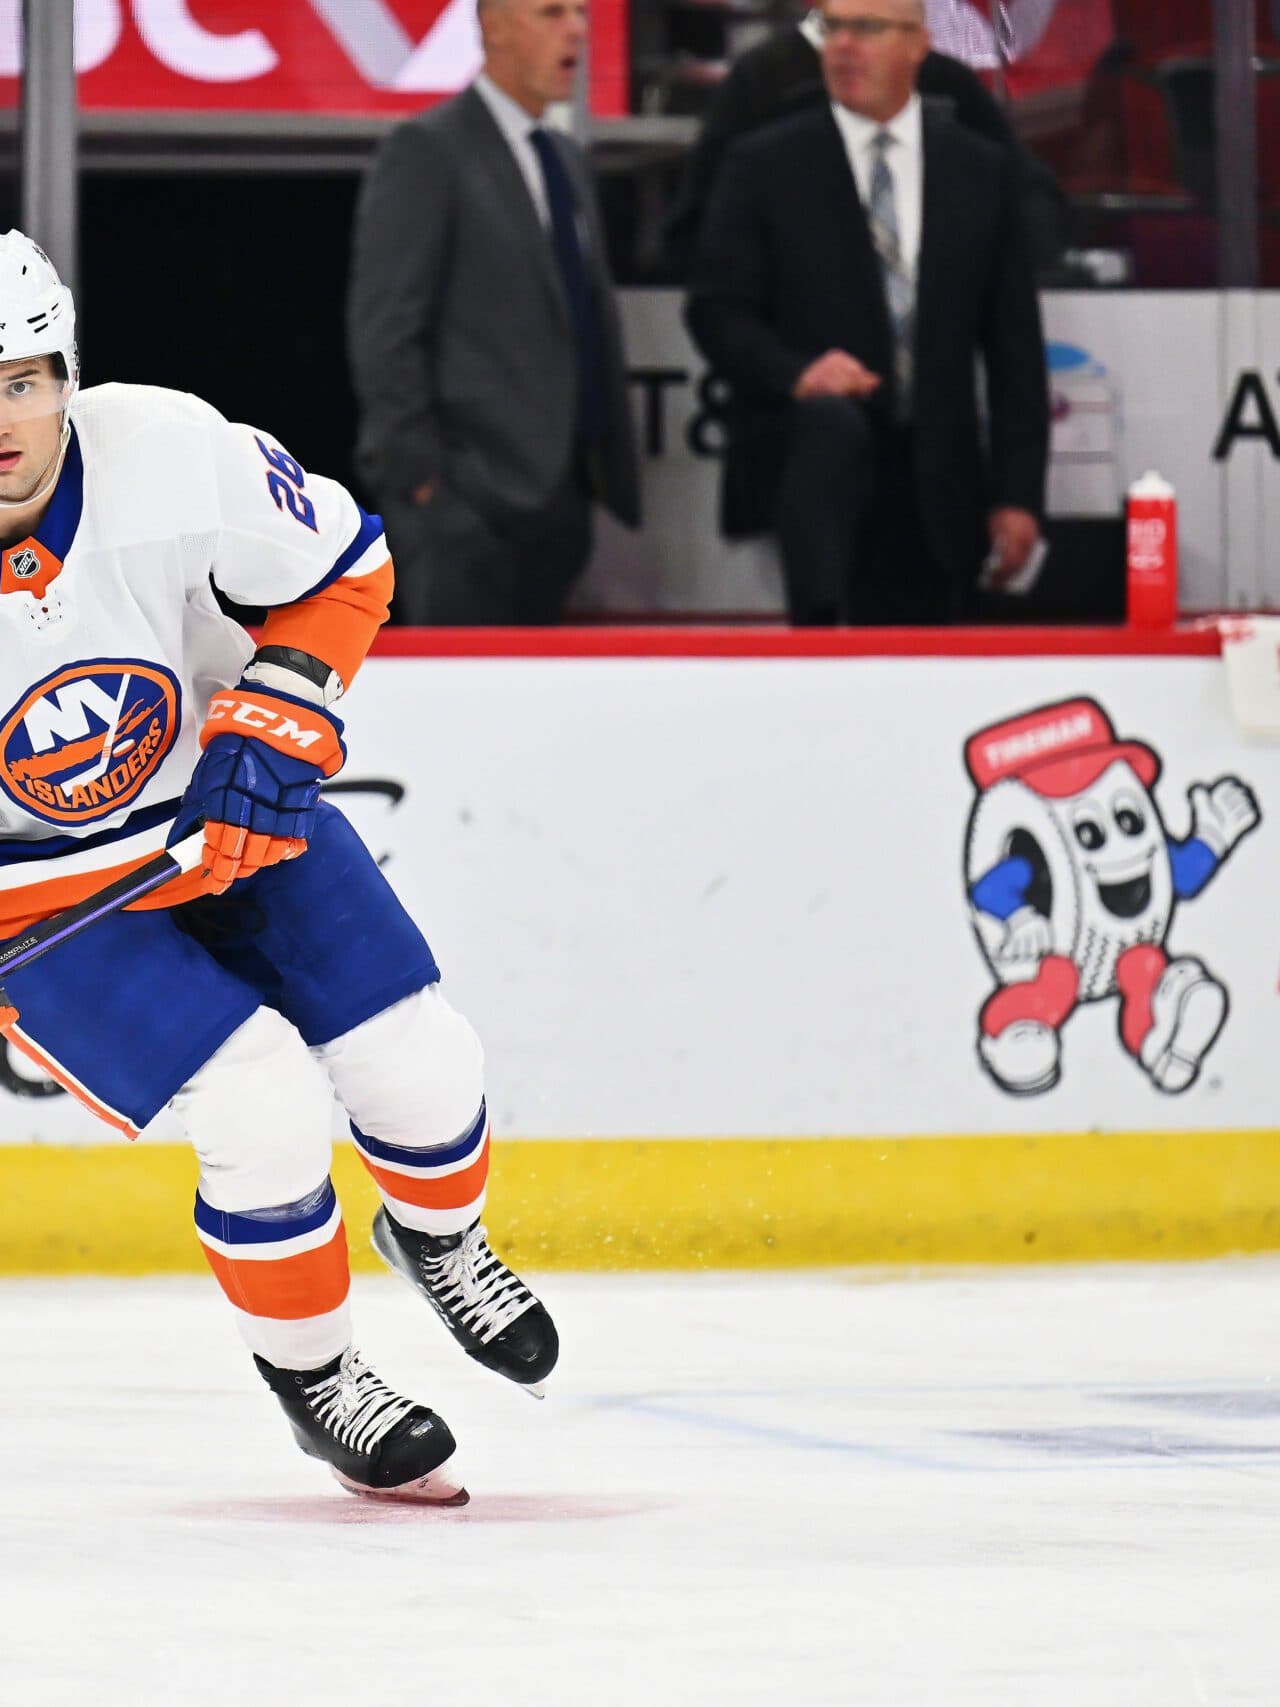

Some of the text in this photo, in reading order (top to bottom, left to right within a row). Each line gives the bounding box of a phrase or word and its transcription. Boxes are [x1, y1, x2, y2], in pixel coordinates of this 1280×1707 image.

[253, 433, 320, 535] 26
[23, 673, 131, 754] NY
[208, 699, 324, 749] CCM
[24, 716, 163, 810] ISLANDERS
